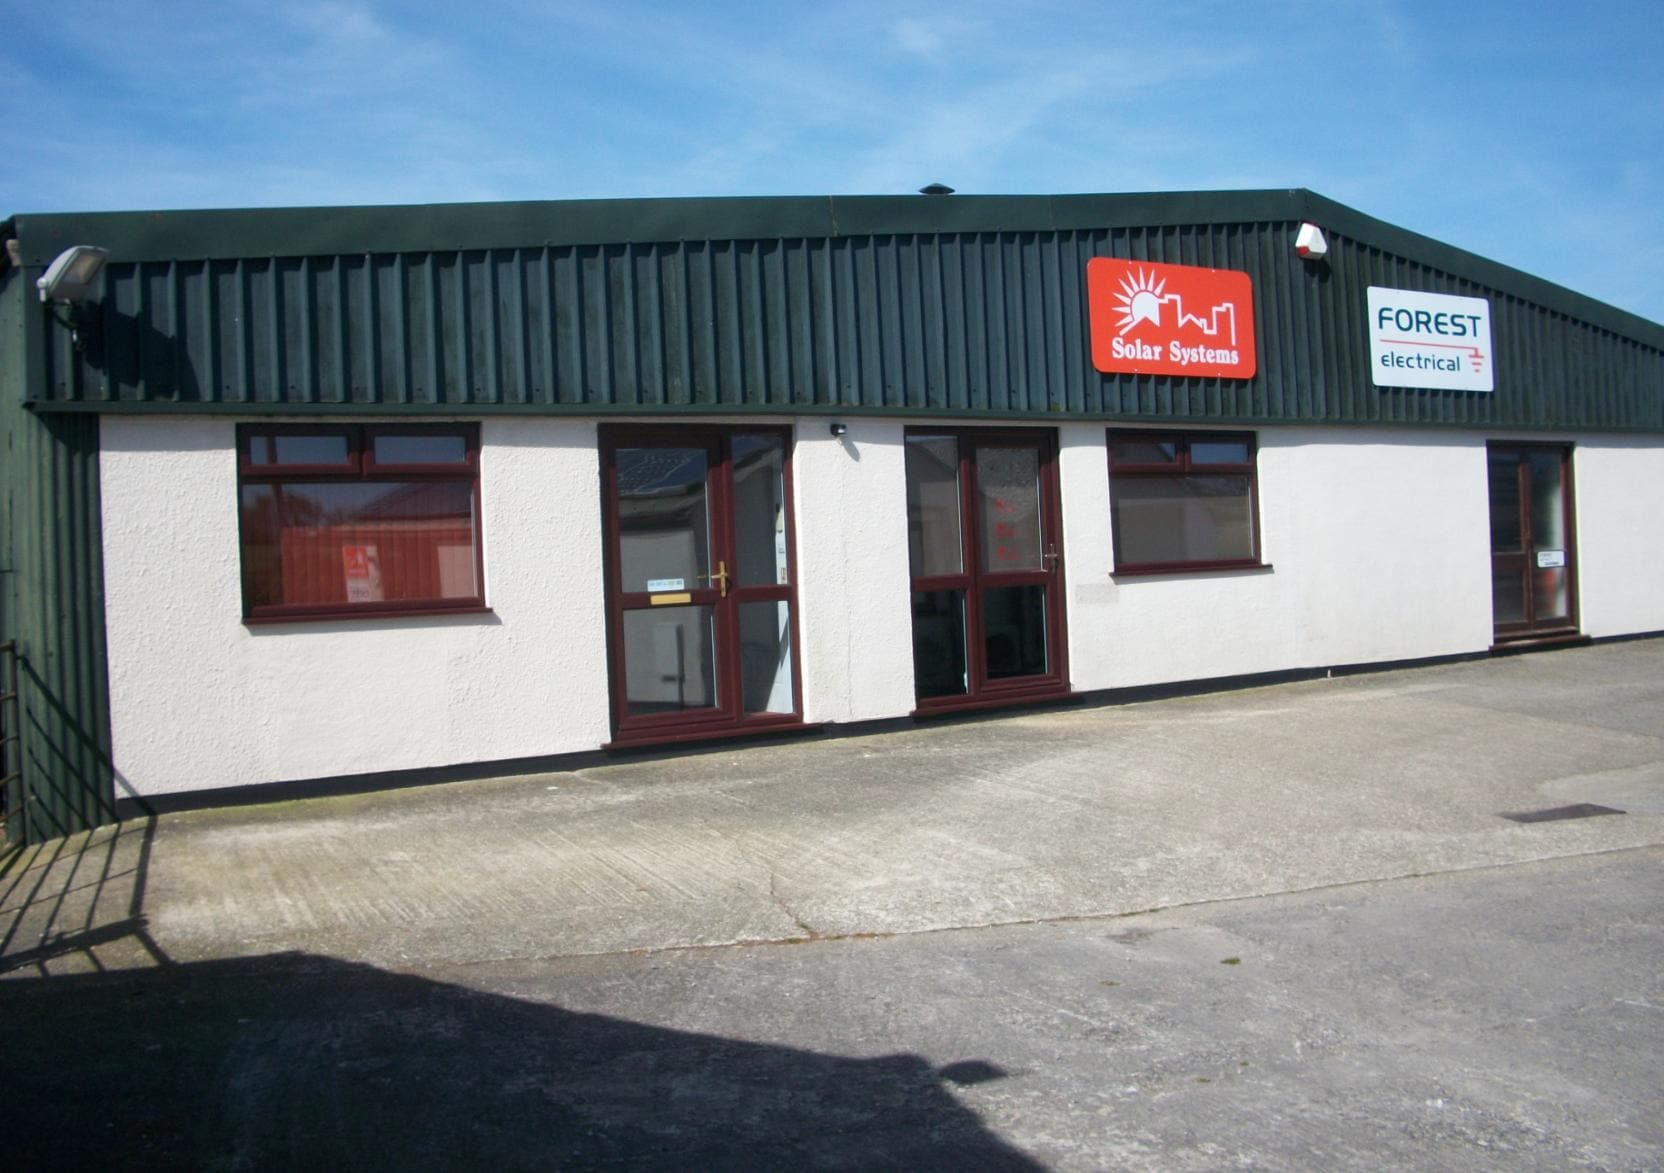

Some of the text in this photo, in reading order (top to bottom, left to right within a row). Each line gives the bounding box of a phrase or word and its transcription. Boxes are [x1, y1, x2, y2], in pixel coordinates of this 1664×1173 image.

[1378, 306, 1482, 338] FOREST
[1111, 336, 1240, 366] Solar Systems
[1380, 351, 1461, 372] electrical
